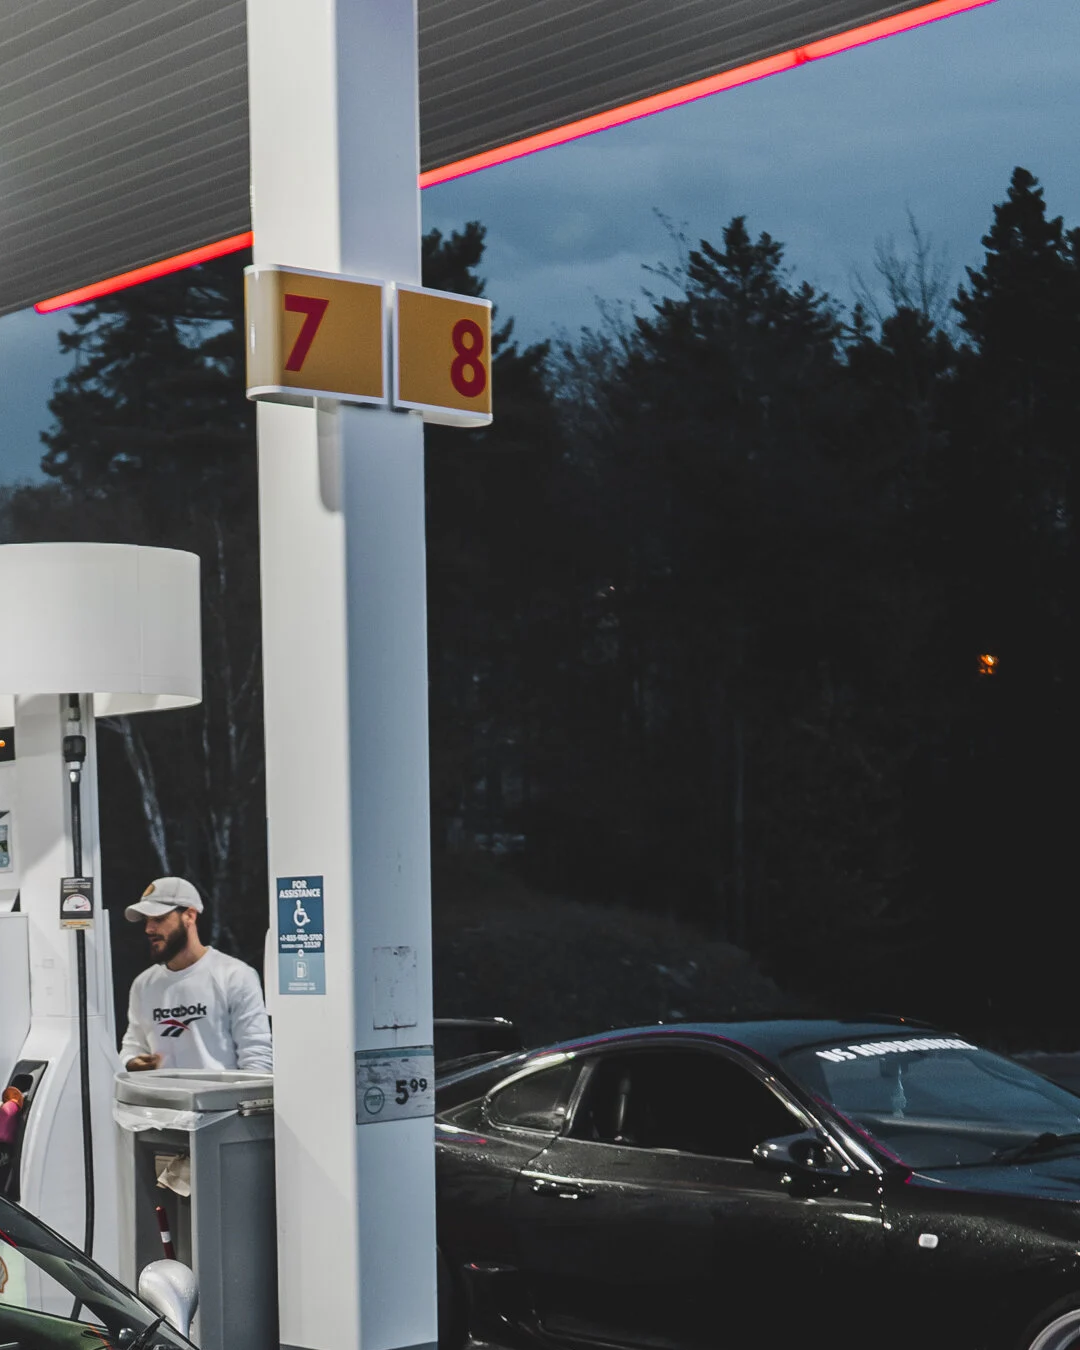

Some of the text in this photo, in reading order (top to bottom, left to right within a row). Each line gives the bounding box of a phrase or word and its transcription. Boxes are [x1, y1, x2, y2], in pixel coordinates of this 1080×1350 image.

[284, 293, 330, 372] 7
[450, 319, 487, 398] 8
[279, 889, 321, 898] ASSISTANCE
[292, 880, 307, 889] FOR
[153, 1003, 207, 1021] Reebok
